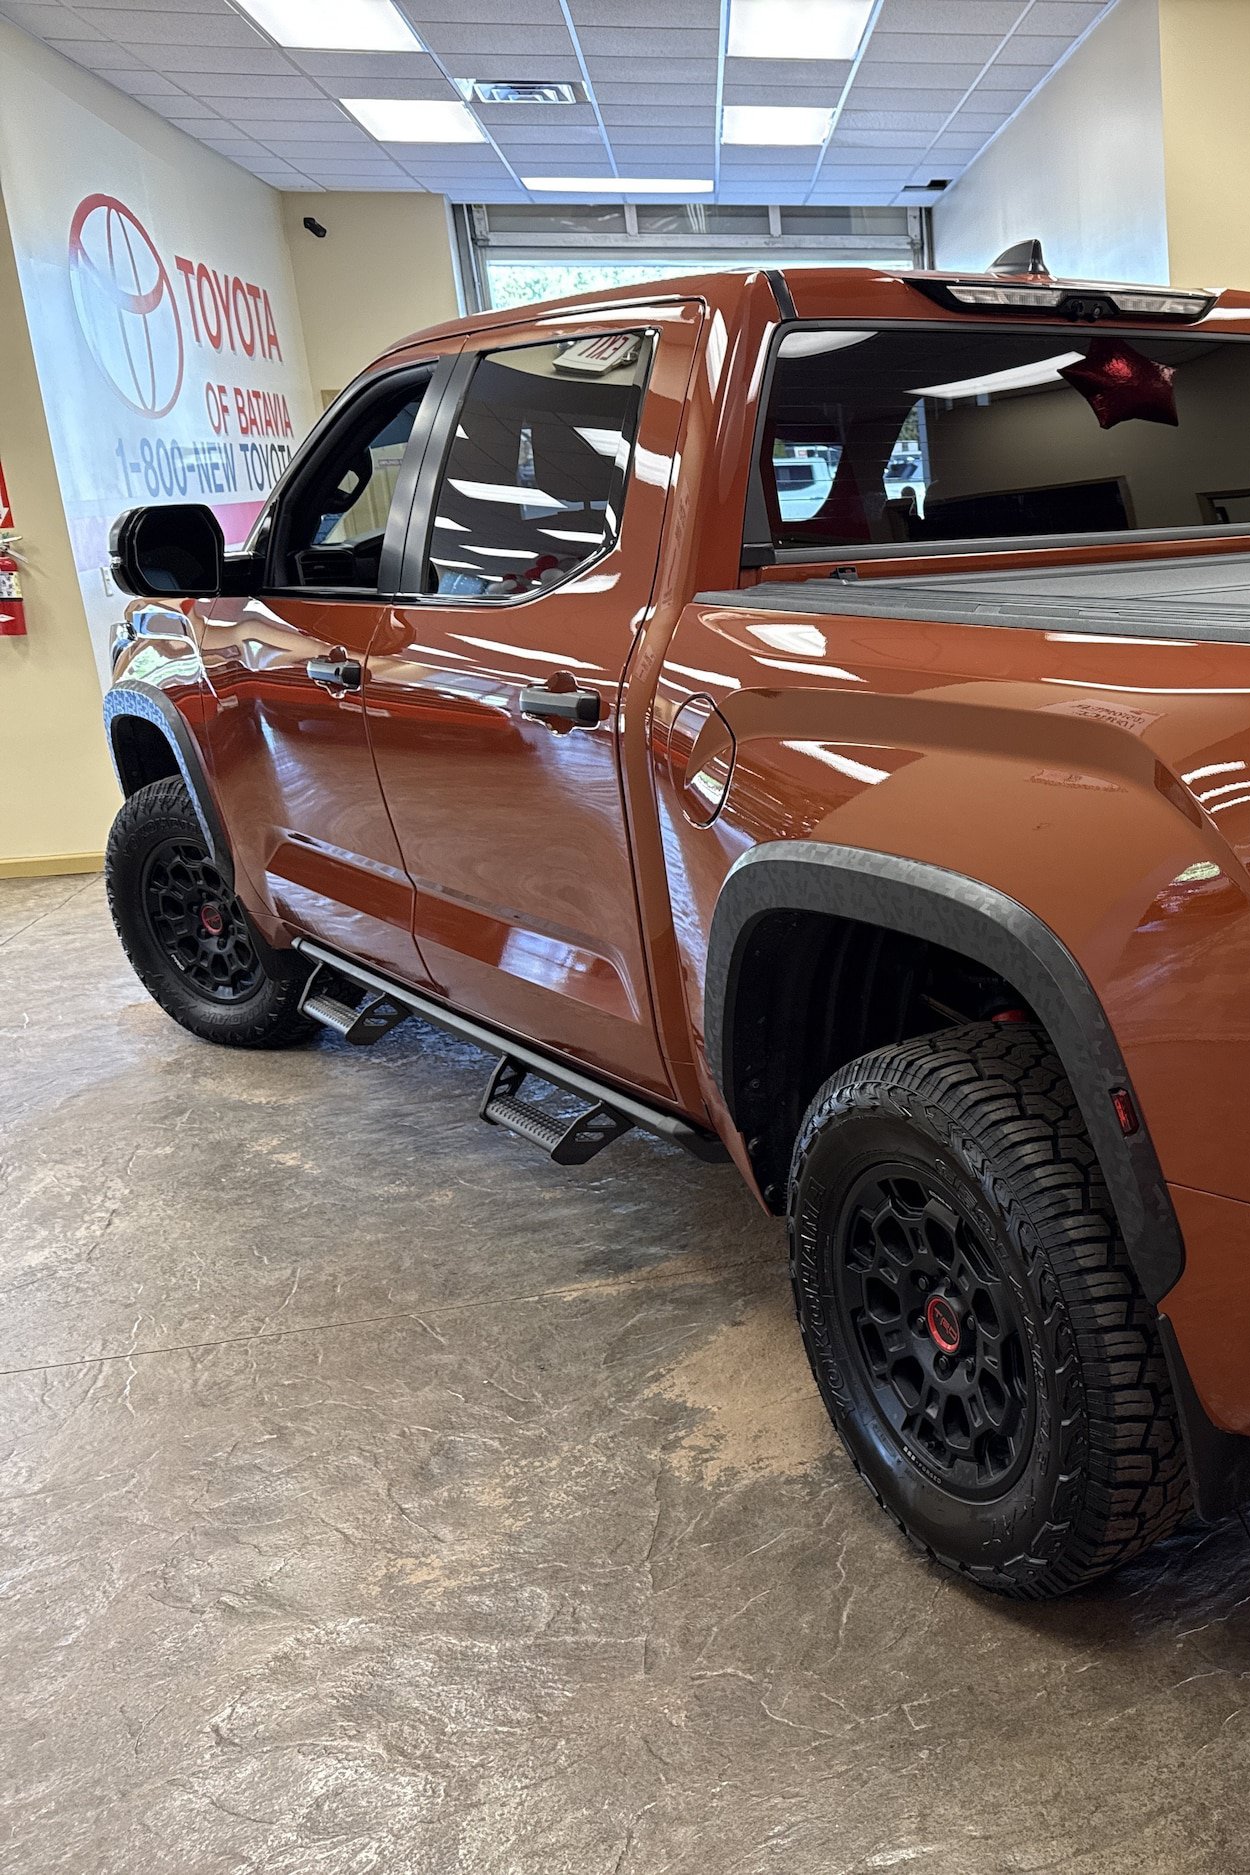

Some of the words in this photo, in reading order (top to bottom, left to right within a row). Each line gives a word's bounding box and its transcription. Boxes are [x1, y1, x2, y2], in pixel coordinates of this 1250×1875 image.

[174, 254, 283, 363] TOYOTA
[205, 382, 230, 435] OF
[233, 387, 294, 438] BATAVIA
[116, 438, 237, 498] 1-800-NEW
[934, 1307, 958, 1341] TRD
